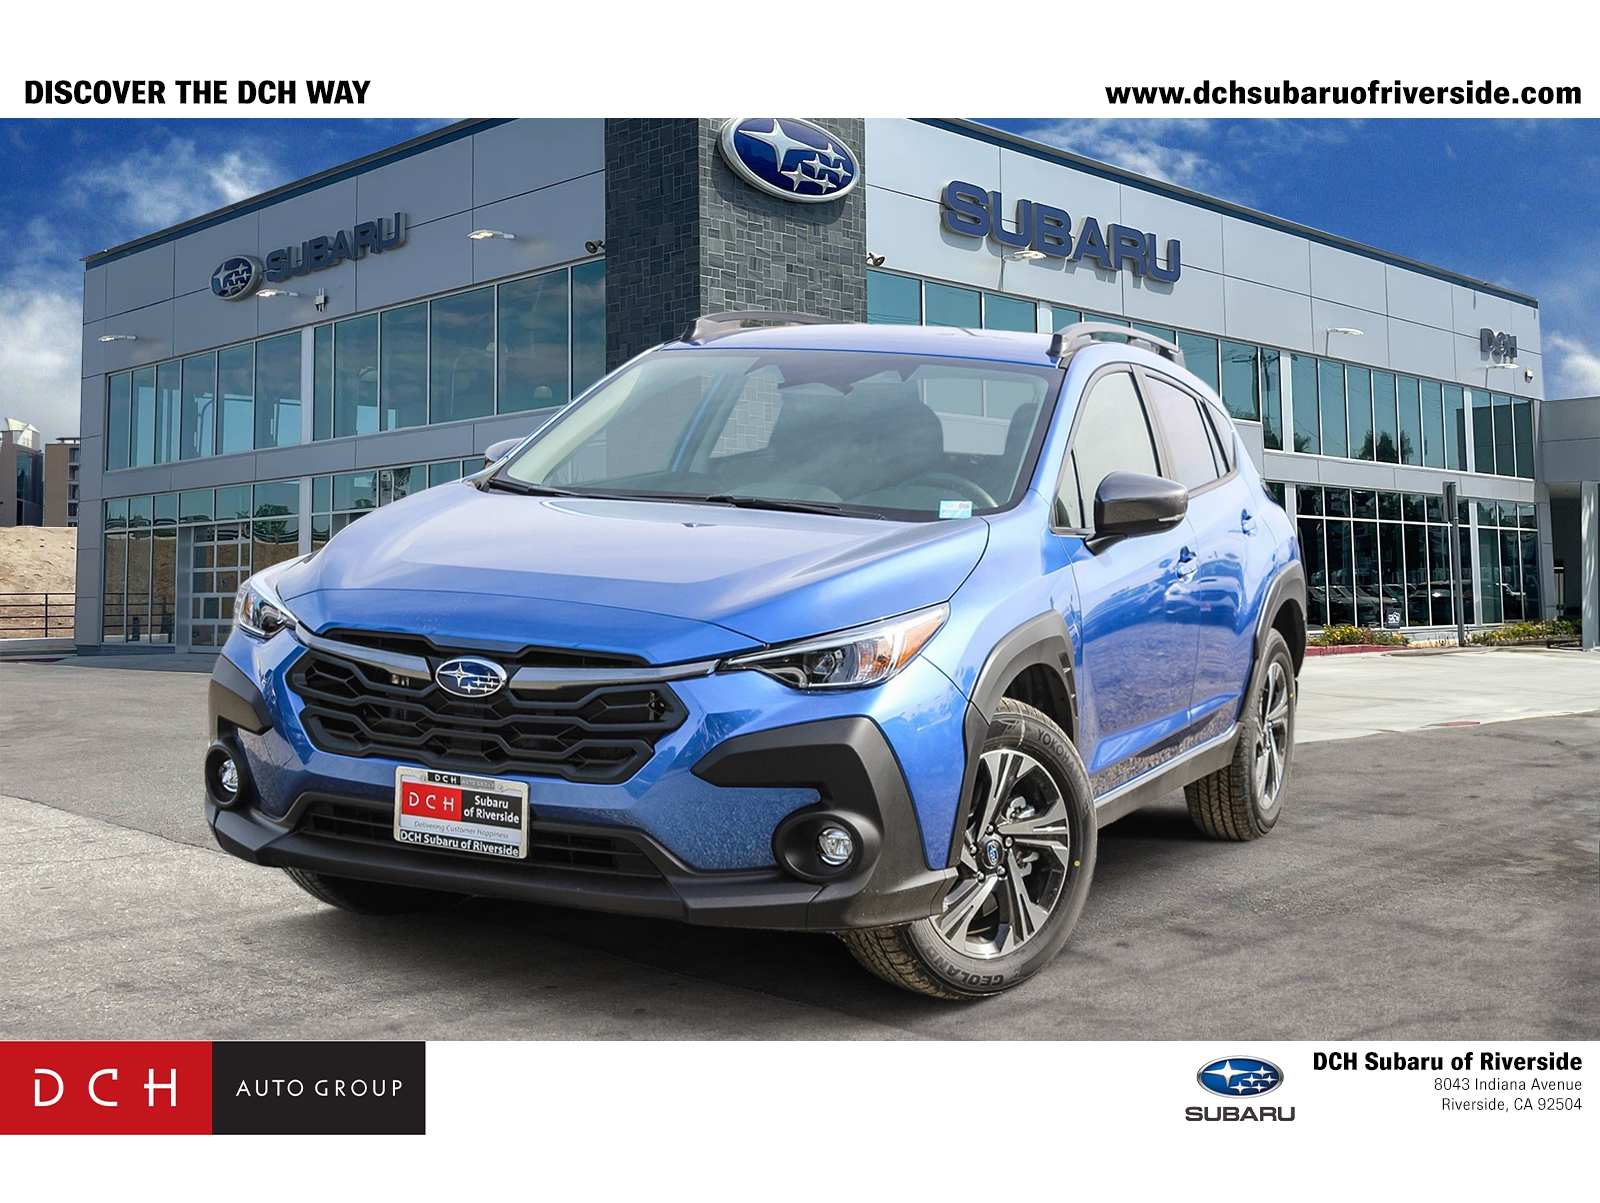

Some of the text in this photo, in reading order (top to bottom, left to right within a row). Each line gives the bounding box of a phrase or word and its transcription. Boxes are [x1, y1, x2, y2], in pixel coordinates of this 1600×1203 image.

[940, 180, 1180, 282] SUBARU
[266, 212, 406, 282] SUBARU
[434, 773, 458, 784] DCH
[409, 791, 454, 812] DCH
[474, 795, 509, 809] Subaru
[464, 808, 520, 824] of Riverside
[401, 831, 519, 857] DCH Subaru of Riverside
